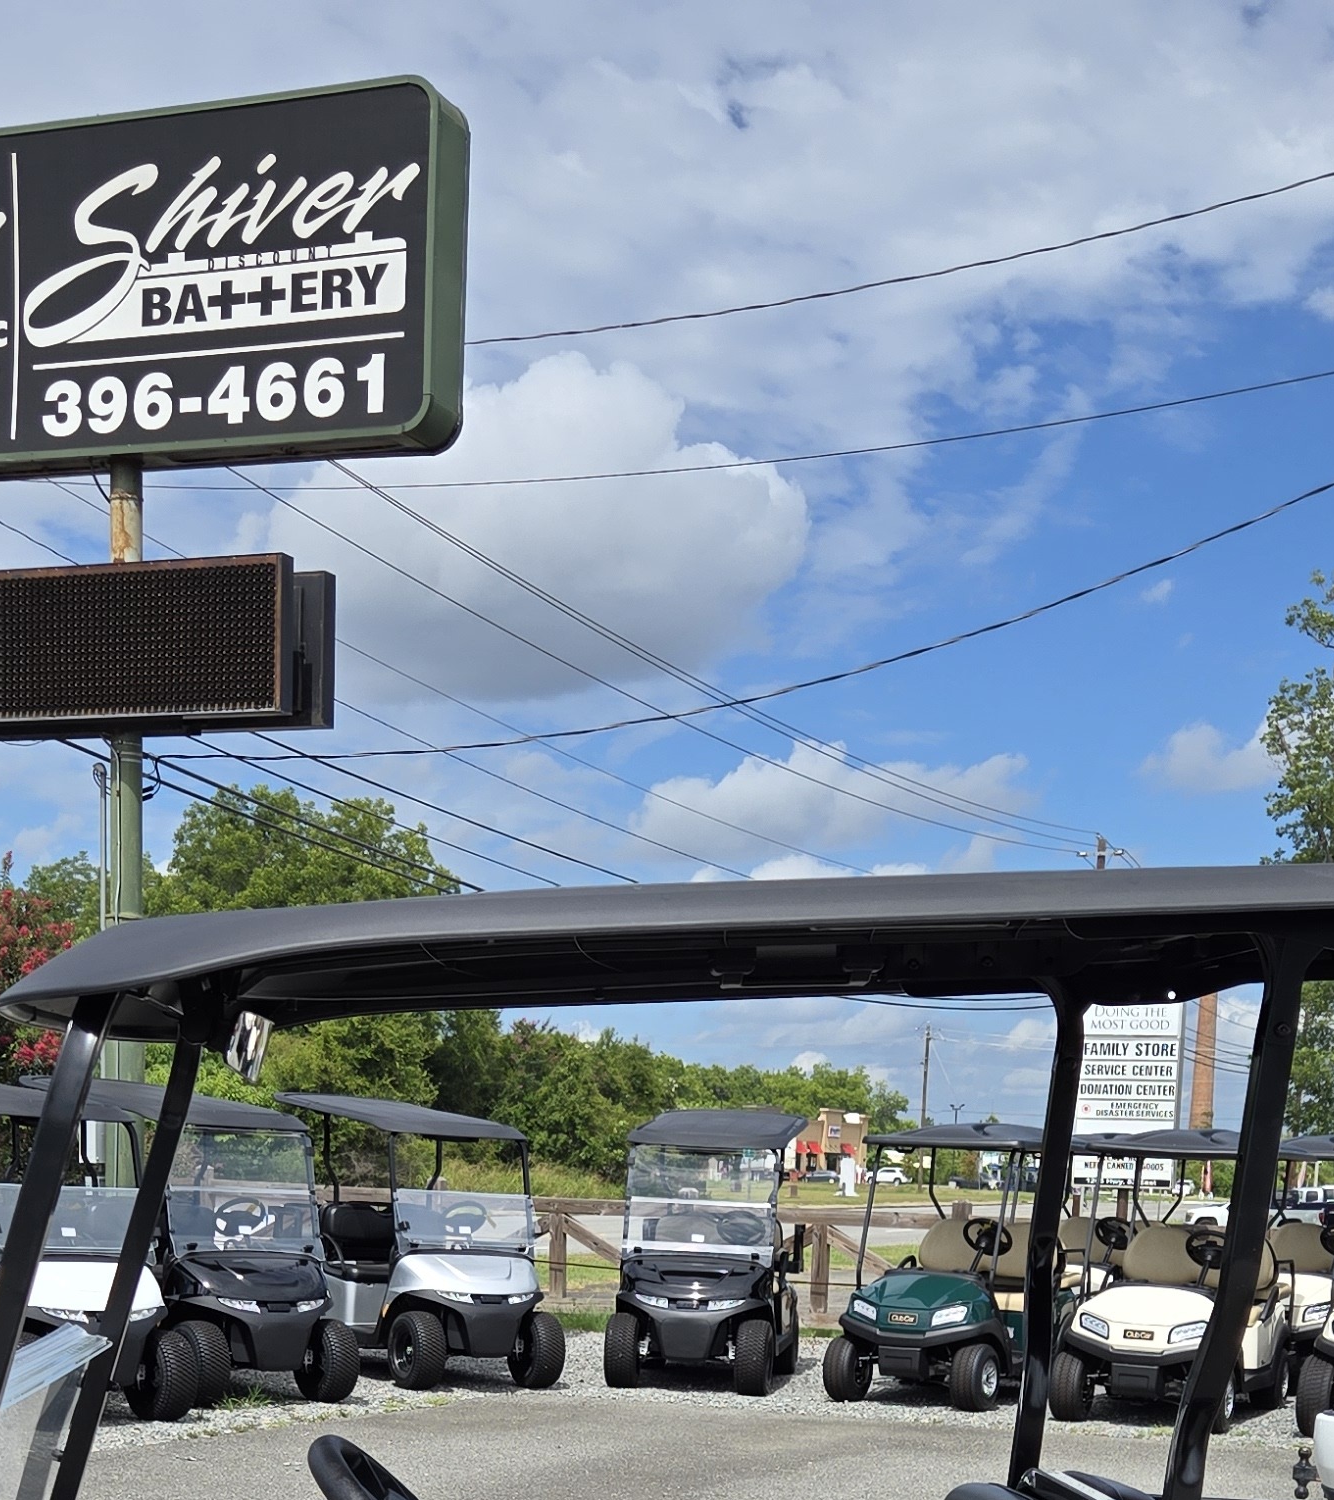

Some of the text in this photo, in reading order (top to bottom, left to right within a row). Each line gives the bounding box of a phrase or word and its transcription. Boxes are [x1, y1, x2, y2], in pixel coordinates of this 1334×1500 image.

[23, 152, 421, 348] Shiver
[208, 245, 333, 271] DISCOUNT
[42, 352, 389, 438] 396-4661
[1094, 1006, 1168, 1018] DOING THE
[1091, 1019, 1170, 1031] MOST GOOD
[1084, 1042, 1177, 1058] FAMILY STORE
[1084, 1064, 1173, 1078] SERVICE CENTER
[1080, 1083, 1176, 1097] DONATION CENTER
[1110, 1102, 1159, 1110] EMERGENCY
[1095, 1109, 1174, 1118] DISASTER SERVICES
[1142, 1163, 1164, 1171] OODS
